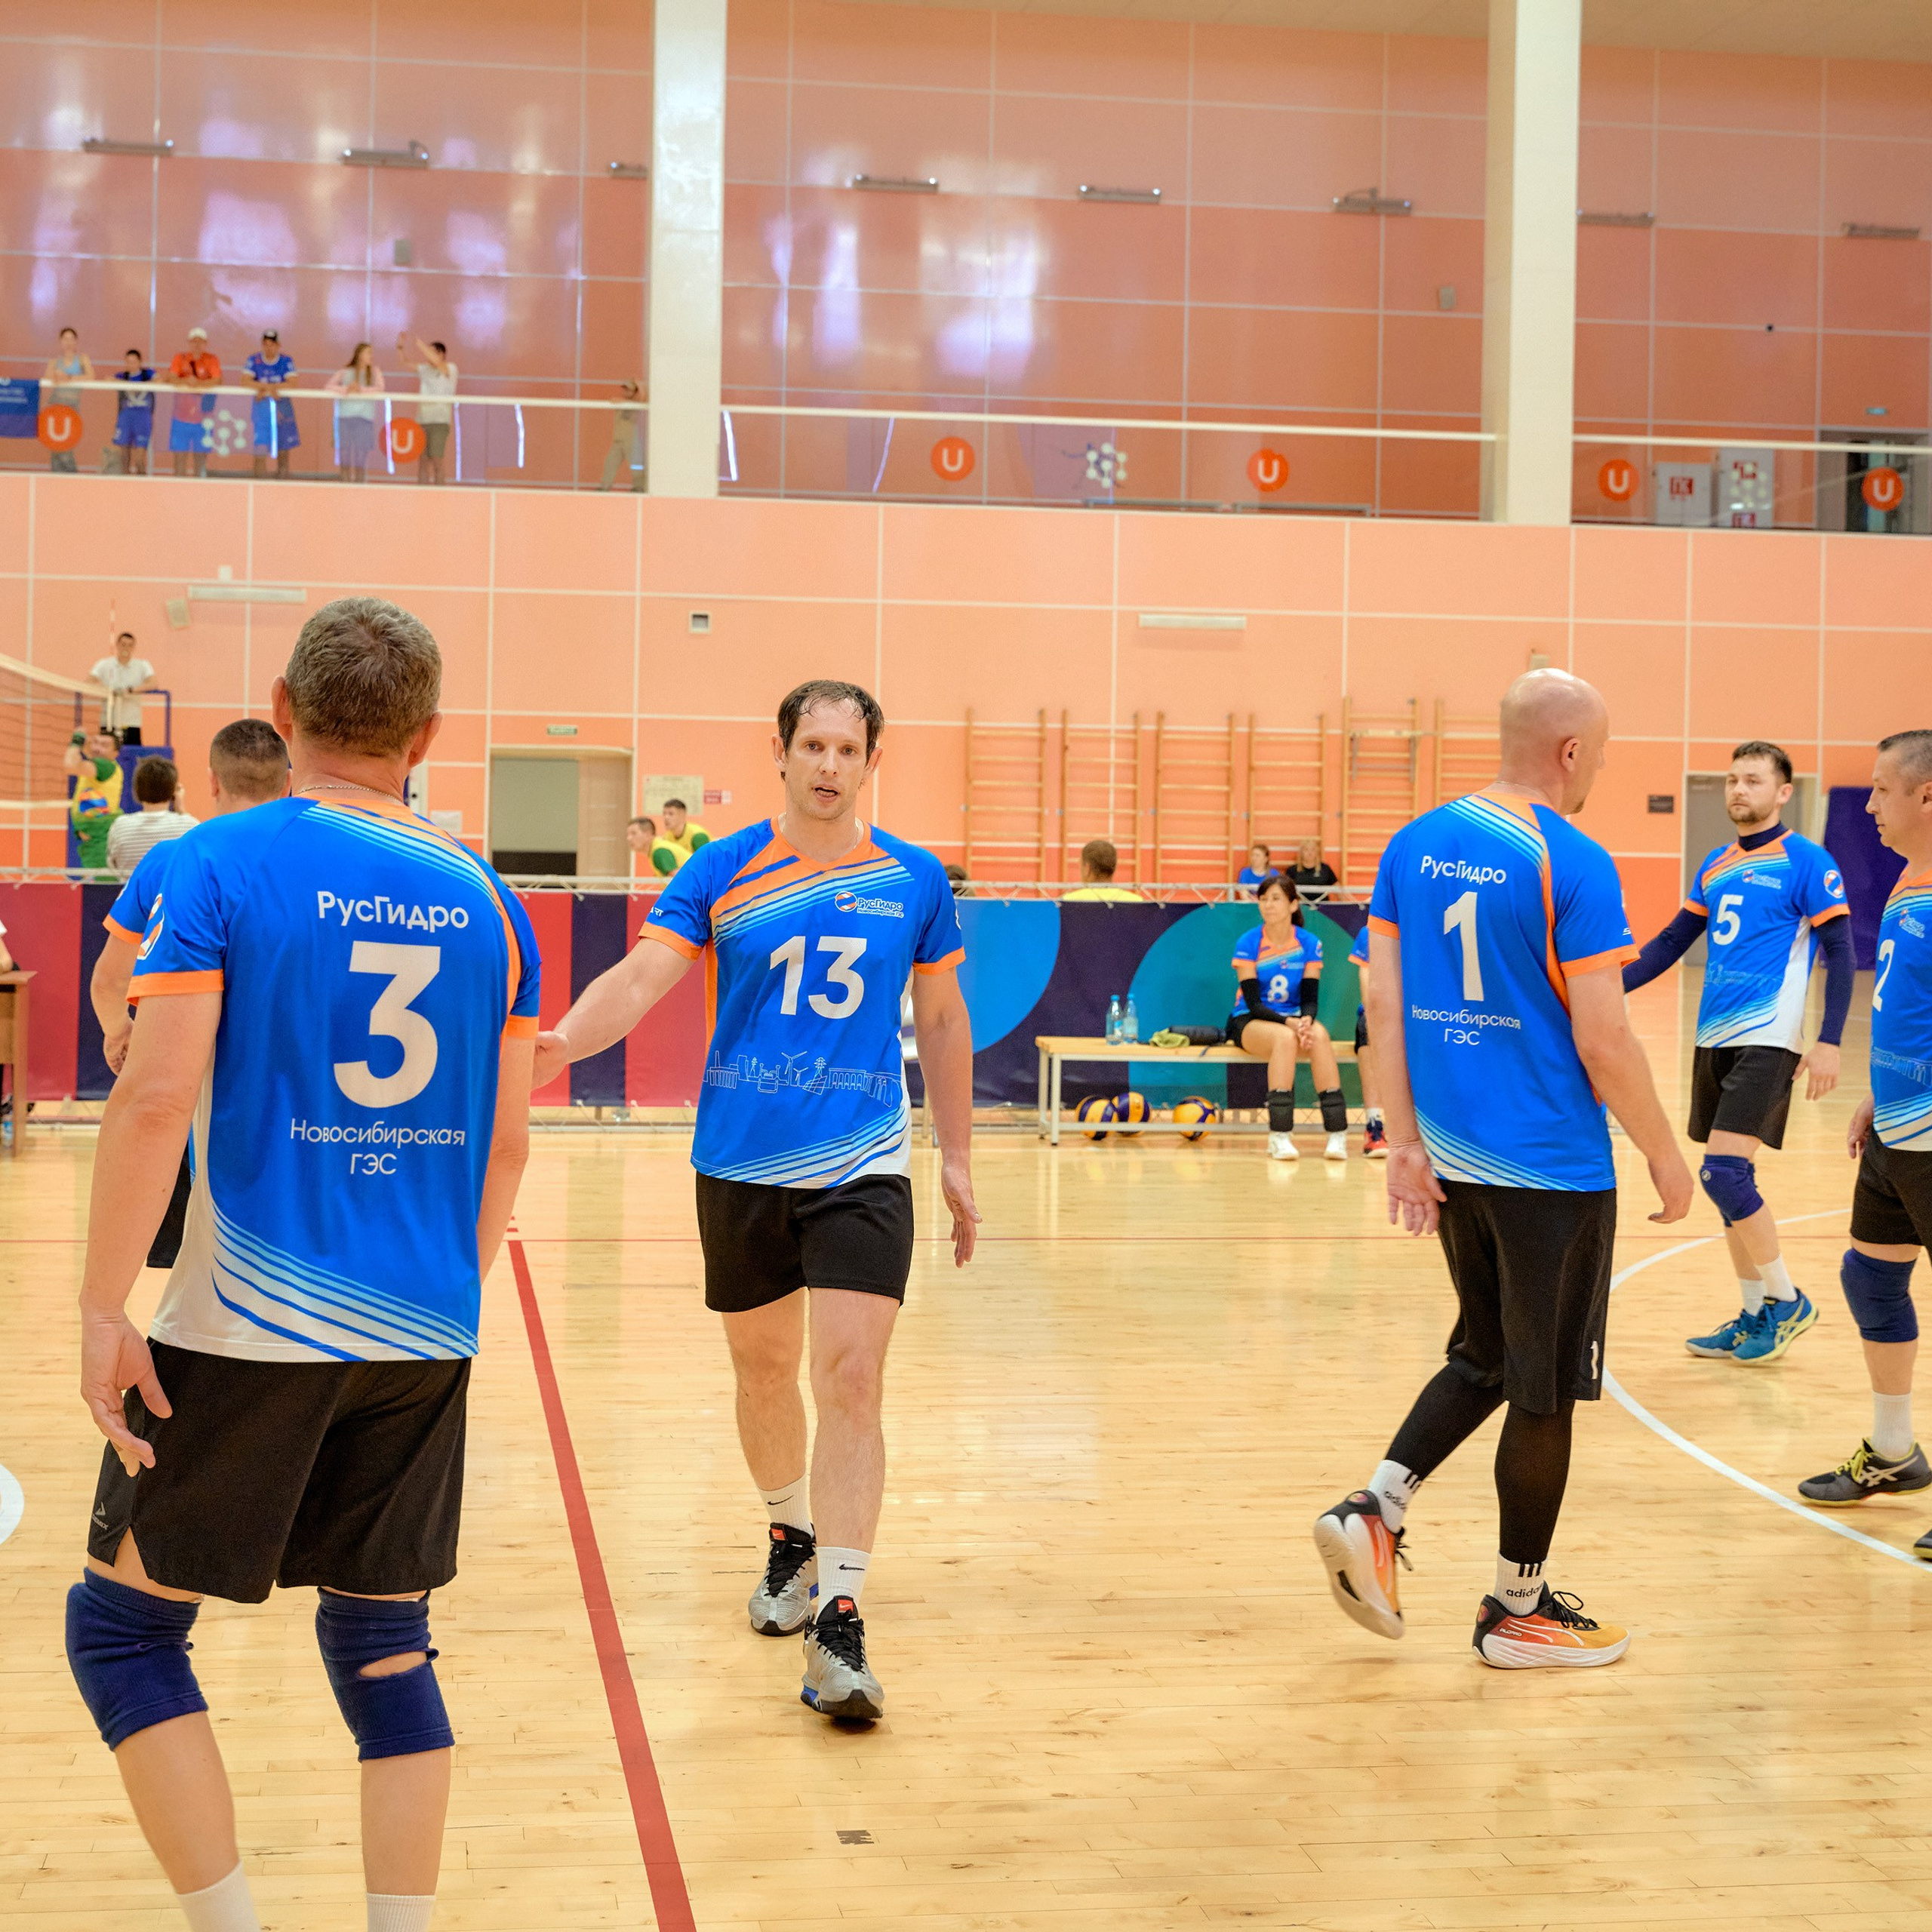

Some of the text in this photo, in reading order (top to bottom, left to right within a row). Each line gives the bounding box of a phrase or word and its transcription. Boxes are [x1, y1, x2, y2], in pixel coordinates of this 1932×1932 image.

[1420, 855, 1506, 885] РусГидро
[317, 891, 469, 933] РусГидро
[857, 897, 903, 911] РусГидро
[1712, 894, 1744, 946] 5
[1444, 891, 1484, 1001] 1
[770, 936, 867, 1019] 13
[1268, 974, 1288, 1003] 8
[1872, 939, 1895, 1012] 2
[334, 940, 441, 1109] 3
[1411, 1004, 1521, 1029] Новосибирская
[1444, 1028, 1480, 1045] ГЭС
[291, 1118, 466, 1149] Новосибирская
[350, 1153, 397, 1175] ГЭС
